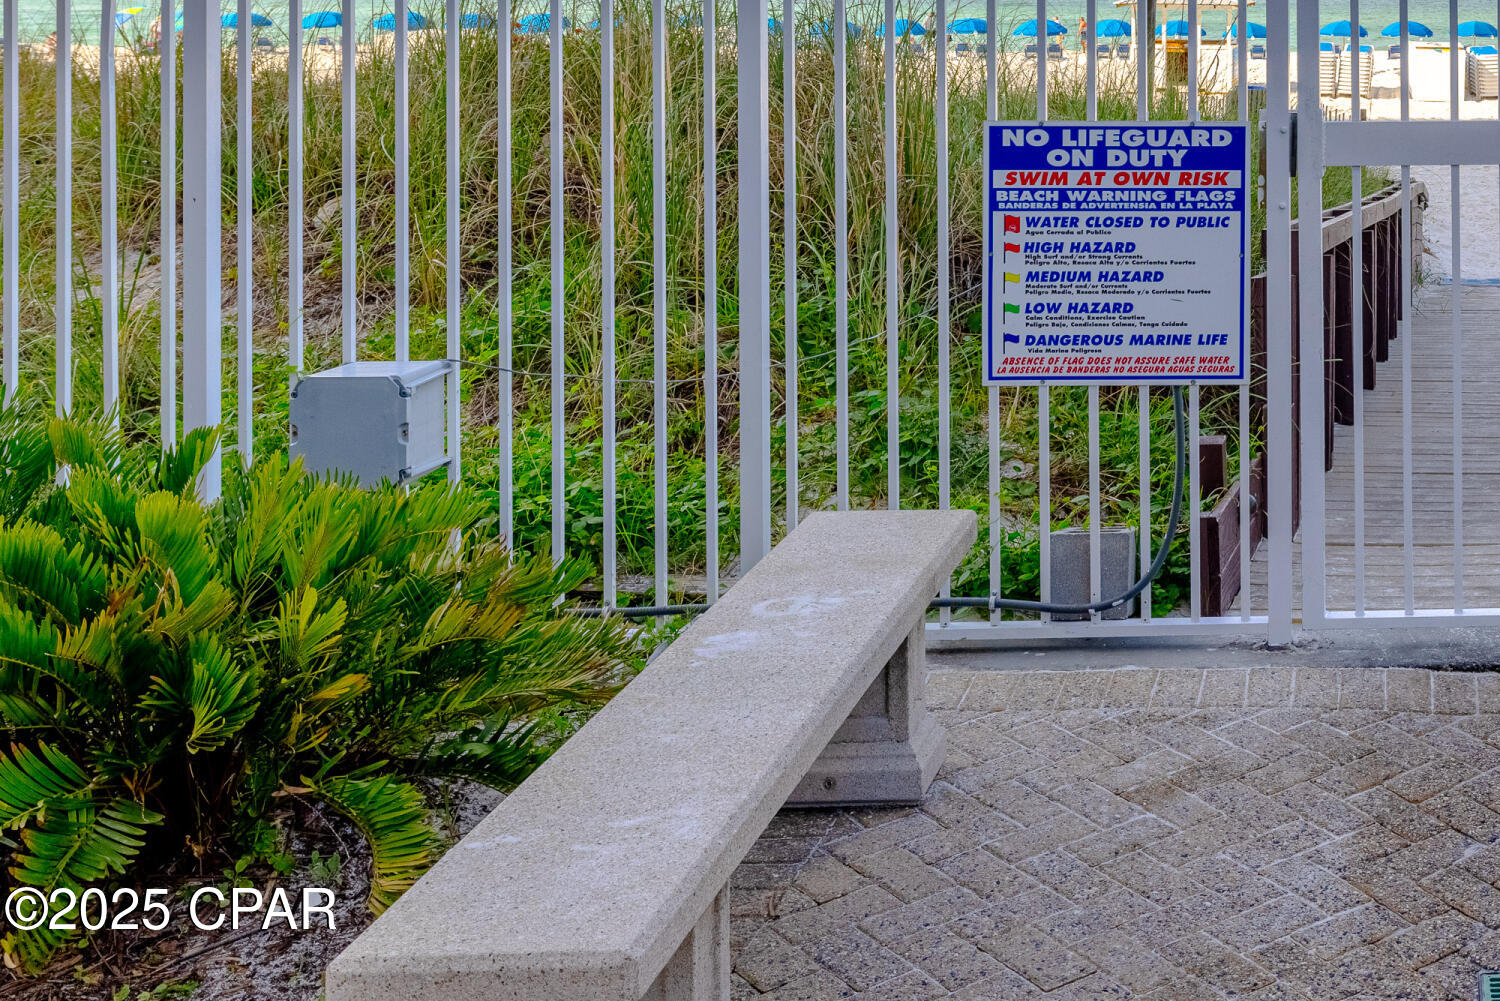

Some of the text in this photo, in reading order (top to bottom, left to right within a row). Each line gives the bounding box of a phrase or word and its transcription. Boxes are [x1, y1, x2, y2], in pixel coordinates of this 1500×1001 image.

[1002, 129, 1232, 147] NO LIFEGUARD
[1046, 149, 1188, 167] ON DUTY
[1004, 171, 1230, 186] SWIM AT OWN RISK
[996, 190, 1236, 202] BEACH WARNING FLAGS
[1026, 216, 1230, 228] WATER CLOSED TO PUBLIC
[1024, 241, 1136, 253] HIGH HAZARD
[1025, 271, 1164, 282] MEDIUM HAZARD
[1025, 302, 1134, 314] LOW HAZARD
[1025, 334, 1228, 346] DANGEROUS MARINE LIFE
[1002, 356, 1230, 365] ABSENCE OF FLAG DOES NOT ASSURE SAFE WATER
[997, 366, 1007, 374] LA
[1009, 366, 1051, 374] AUSENCIA
[1053, 366, 1064, 374] DE
[1066, 366, 1111, 374] BANDERAS
[1113, 366, 1124, 374] NO
[1197, 365, 1236, 373] SEGURAS
